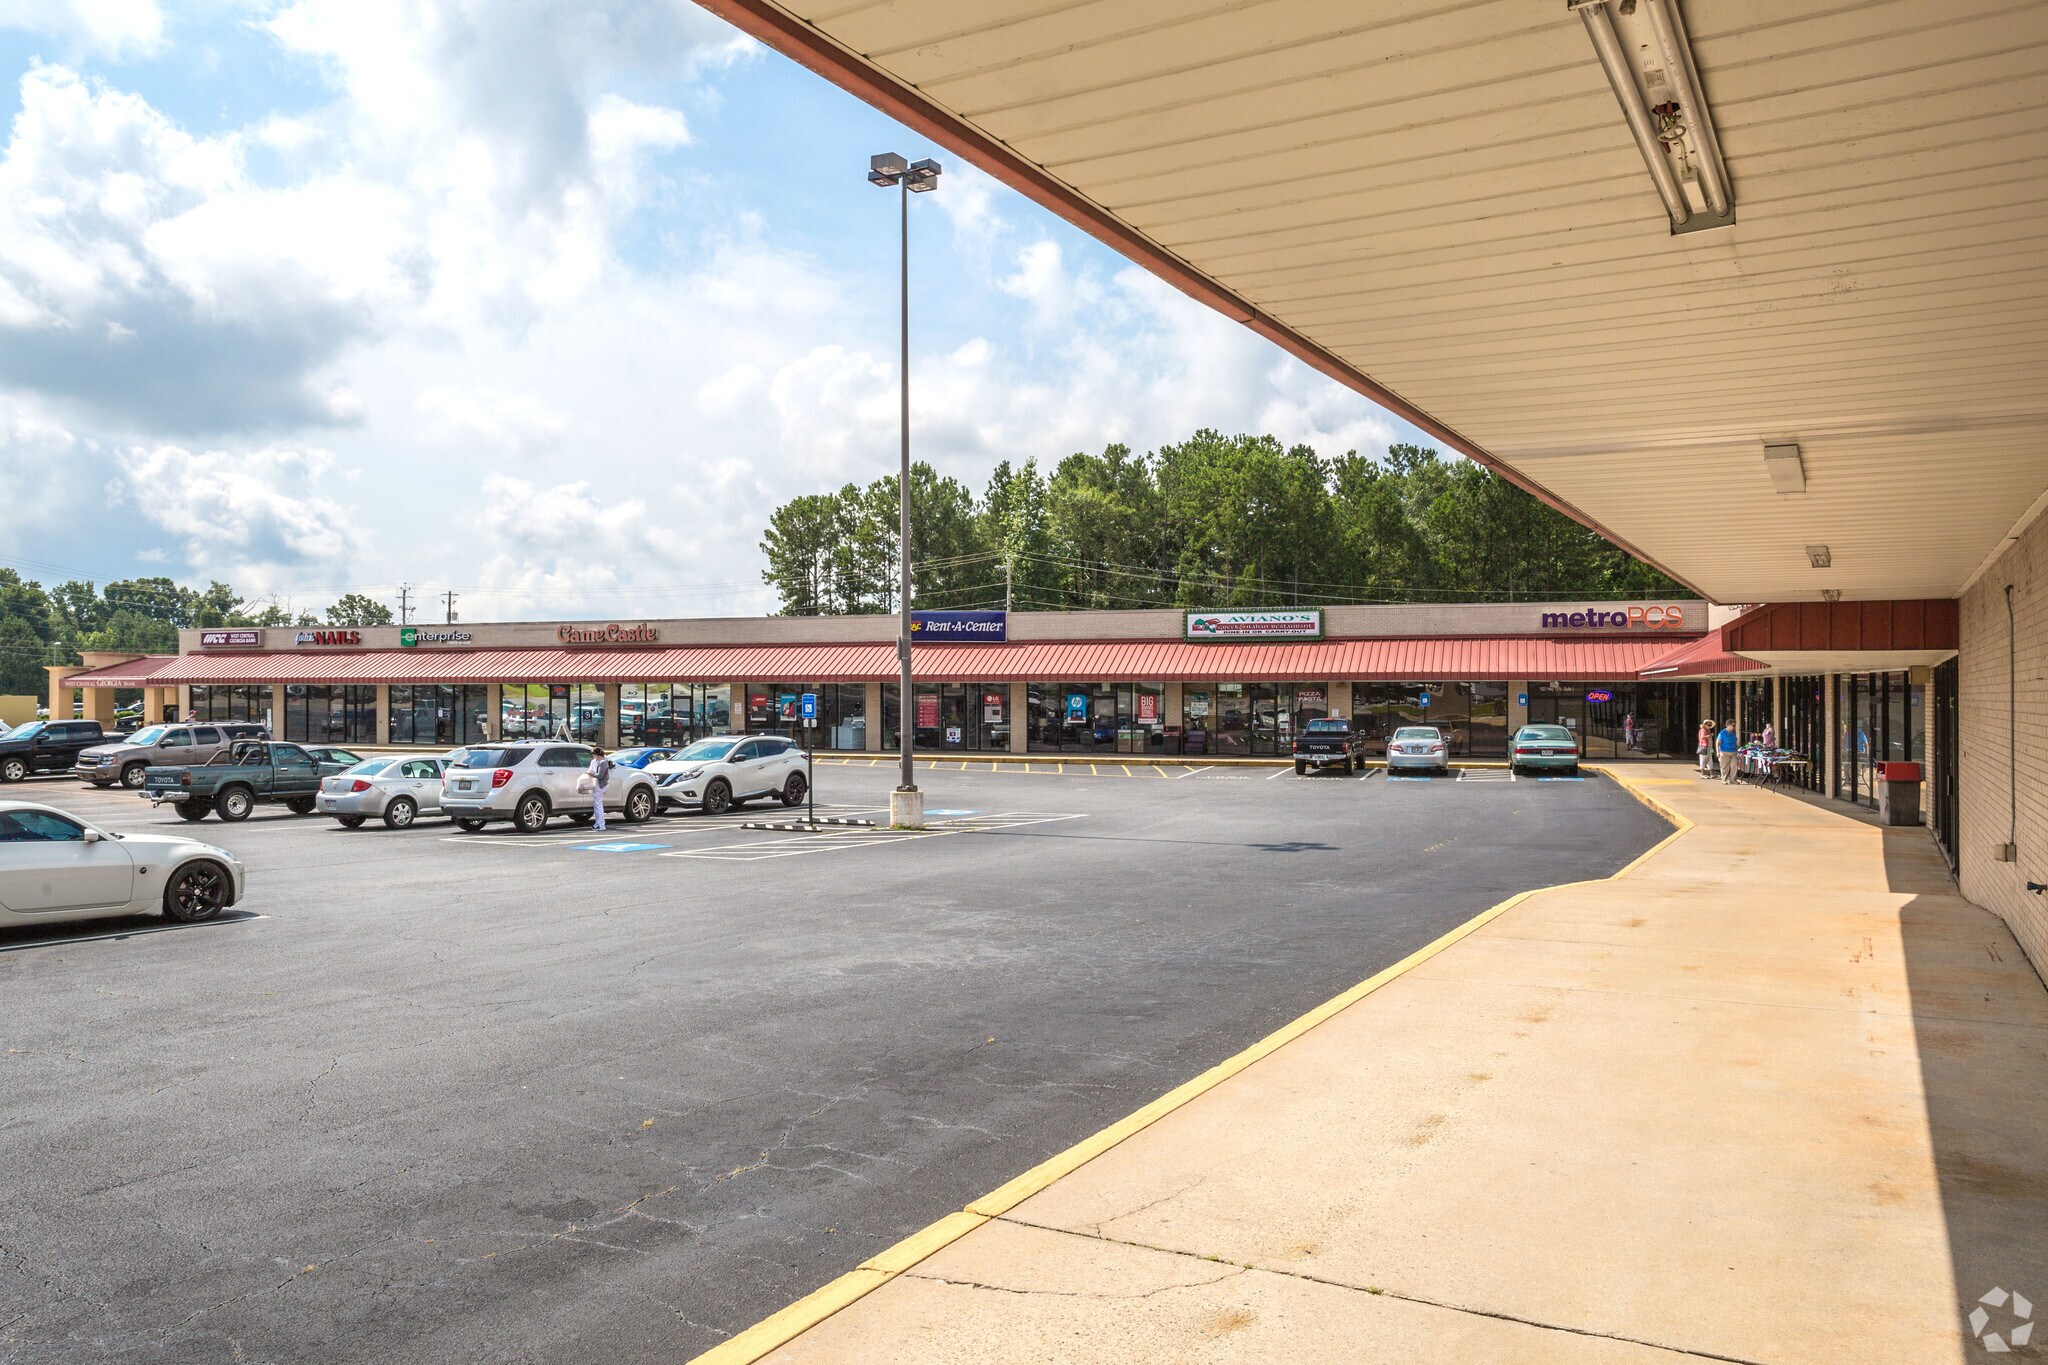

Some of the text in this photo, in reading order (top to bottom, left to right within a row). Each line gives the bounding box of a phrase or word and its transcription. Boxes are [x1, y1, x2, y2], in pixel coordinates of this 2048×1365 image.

[315, 631, 361, 645] NAILS
[404, 630, 471, 643] enterprise
[605, 623, 657, 642] Castle
[1141, 696, 1154, 706] BIG
[1588, 692, 1610, 701] OPEN
[154, 776, 174, 784] TOYOTA
